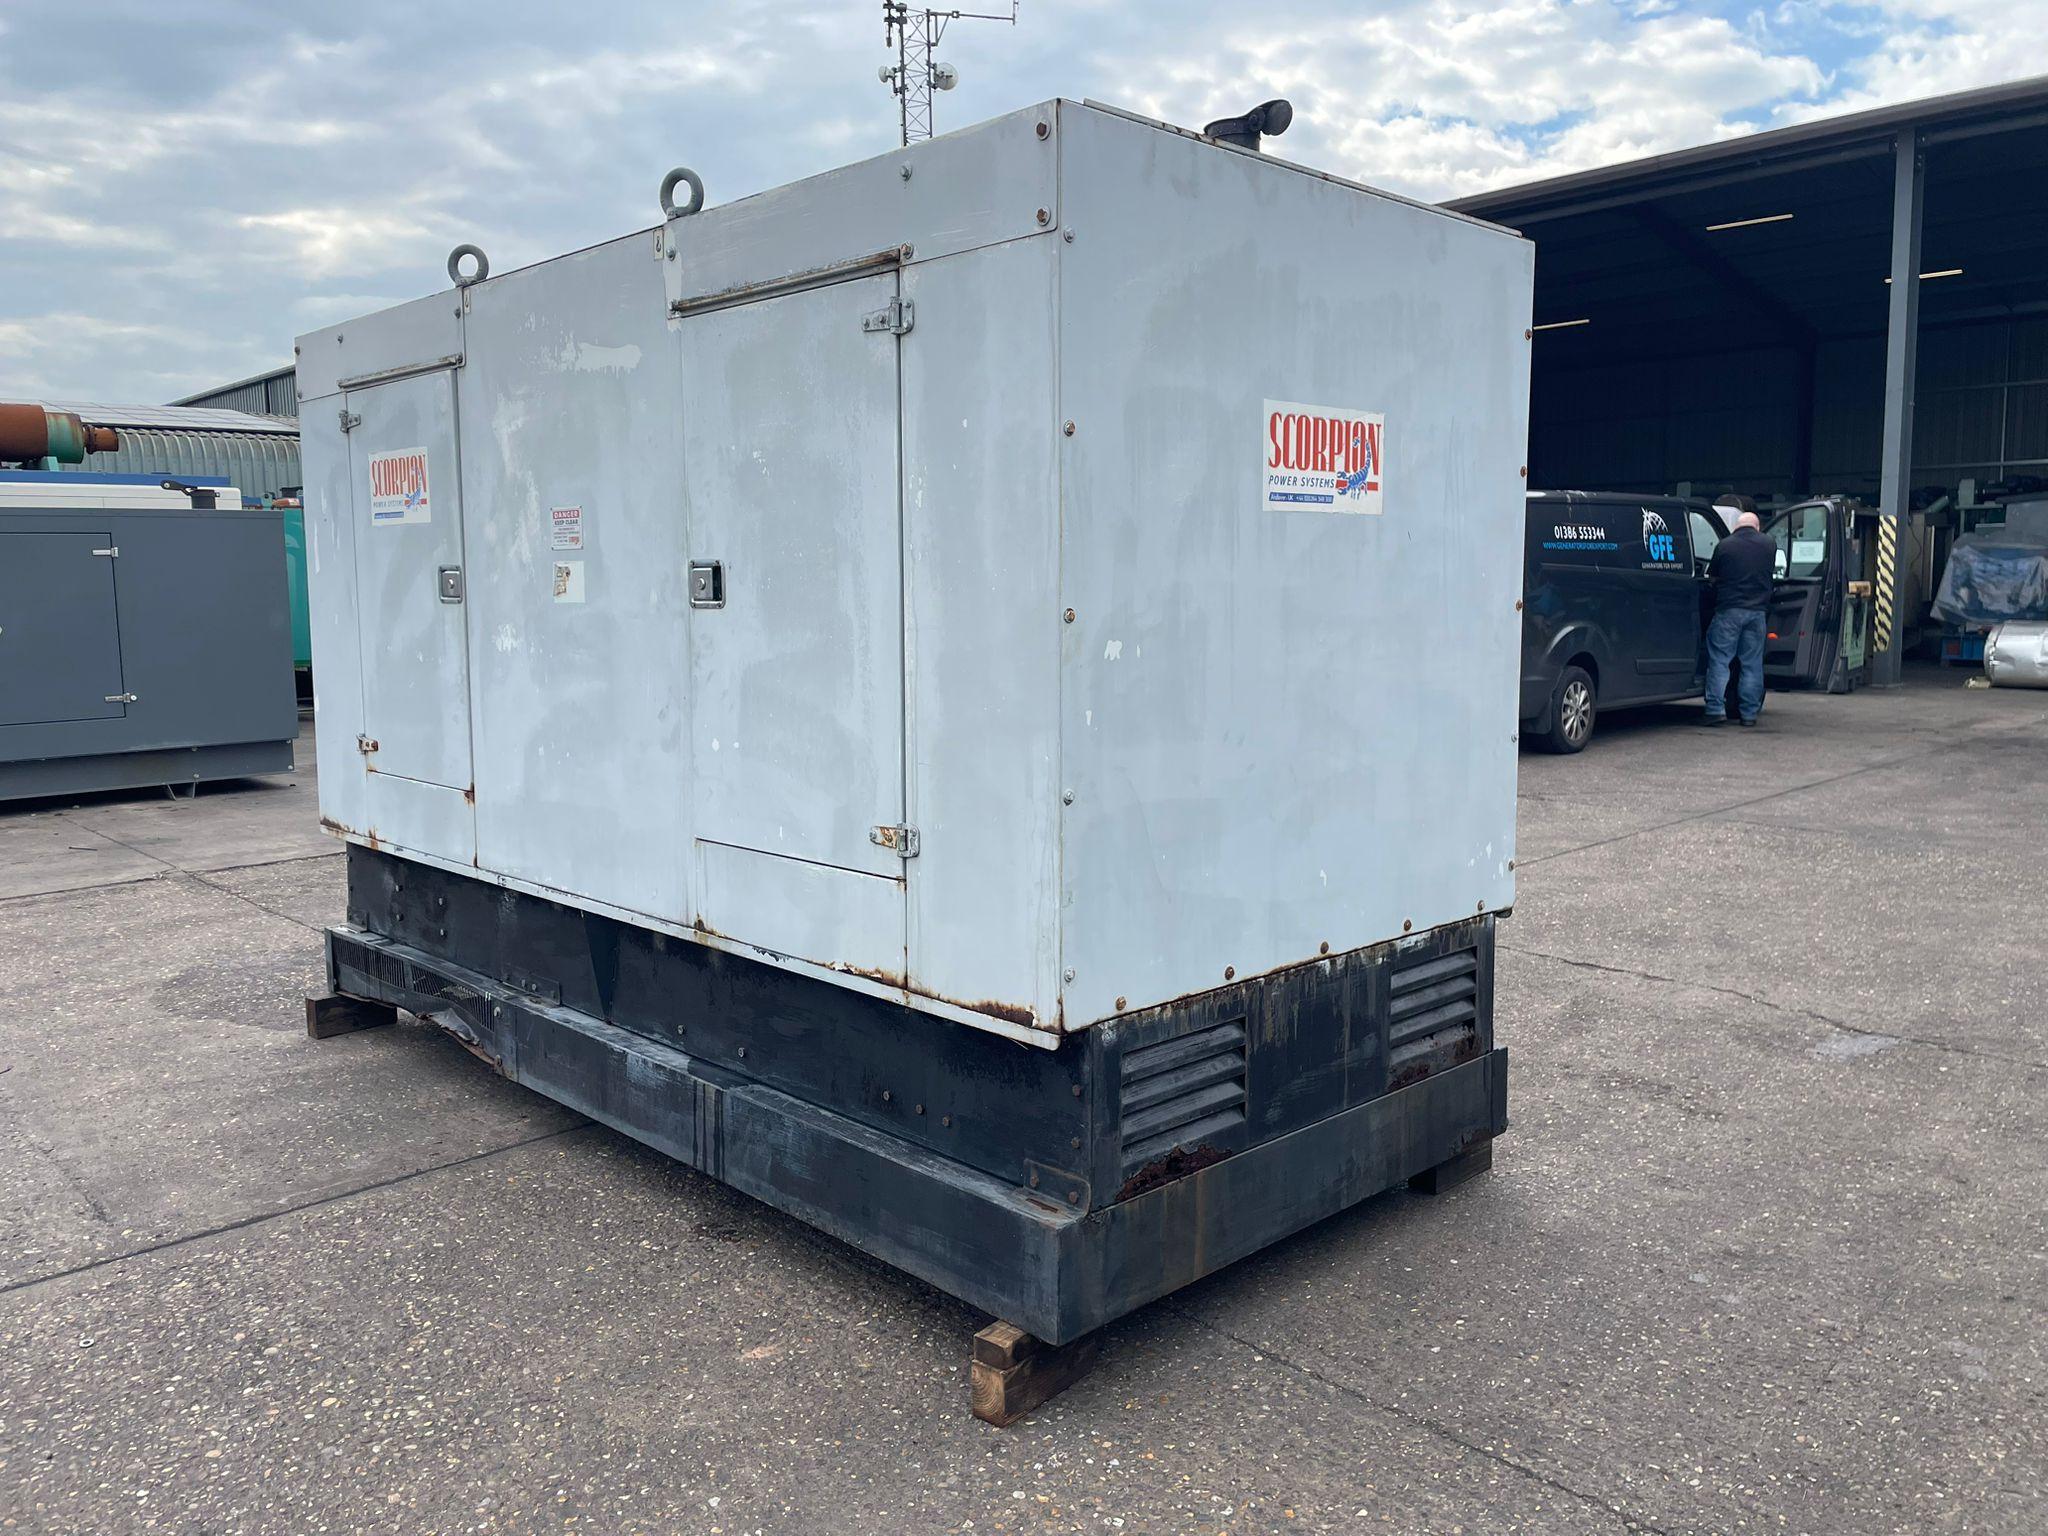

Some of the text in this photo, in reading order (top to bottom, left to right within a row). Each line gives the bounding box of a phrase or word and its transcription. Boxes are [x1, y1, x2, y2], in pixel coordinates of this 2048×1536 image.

[1268, 412, 1381, 476] SCORPION
[371, 454, 427, 497] SCORPION
[1268, 475, 1335, 489] POWER SYSTEMS
[553, 510, 580, 519] DANGER
[1554, 525, 1606, 540] 01386 553344
[1649, 534, 1675, 561] GFE
